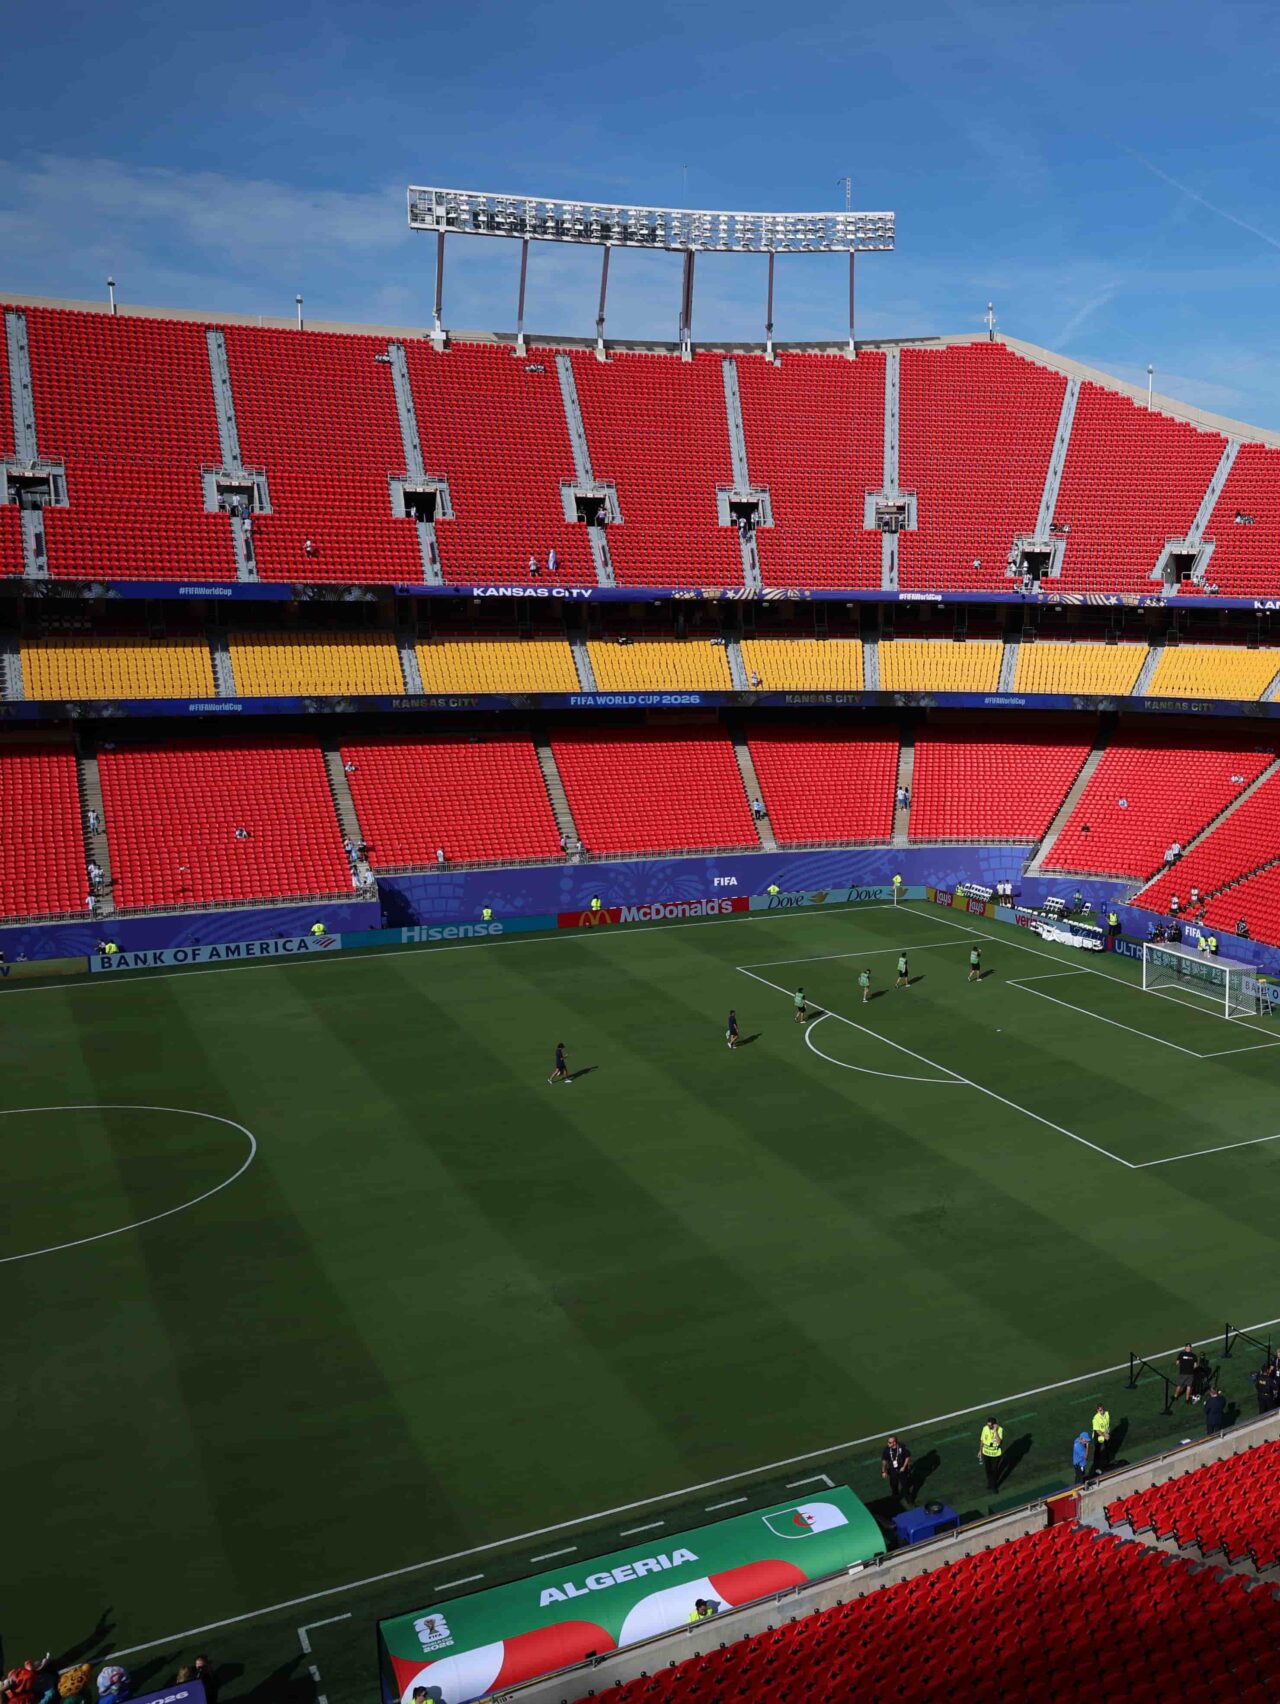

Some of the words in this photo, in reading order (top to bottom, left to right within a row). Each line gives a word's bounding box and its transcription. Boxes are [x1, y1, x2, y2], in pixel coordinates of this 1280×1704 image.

[179, 587, 232, 597] #FIFAWorldCup
[473, 587, 549, 598] KANSAS
[552, 588, 592, 598] CITY
[392, 699, 445, 709] KANSAS
[570, 695, 594, 705] FIFA
[596, 695, 636, 705] WORLD
[638, 695, 660, 705] CUP
[663, 695, 700, 704] 2026
[785, 695, 833, 704] KANSAS
[189, 702, 242, 712] #FIFAWorldCup
[1144, 701, 1189, 711] KANSAS
[713, 876, 738, 887] FIFA
[847, 888, 882, 901] Dove
[768, 894, 804, 909] Dove
[619, 898, 732, 923] McDonald's
[401, 922, 503, 944] Hisense
[1185, 926, 1201, 938] FIFA
[101, 950, 164, 970] BANK
[173, 947, 200, 963] OF
[208, 938, 308, 960] AMERICA
[1115, 939, 1151, 962] ULTRA
[538, 1547, 700, 1607] ALGERIA
[423, 1640, 455, 1653] 2026
